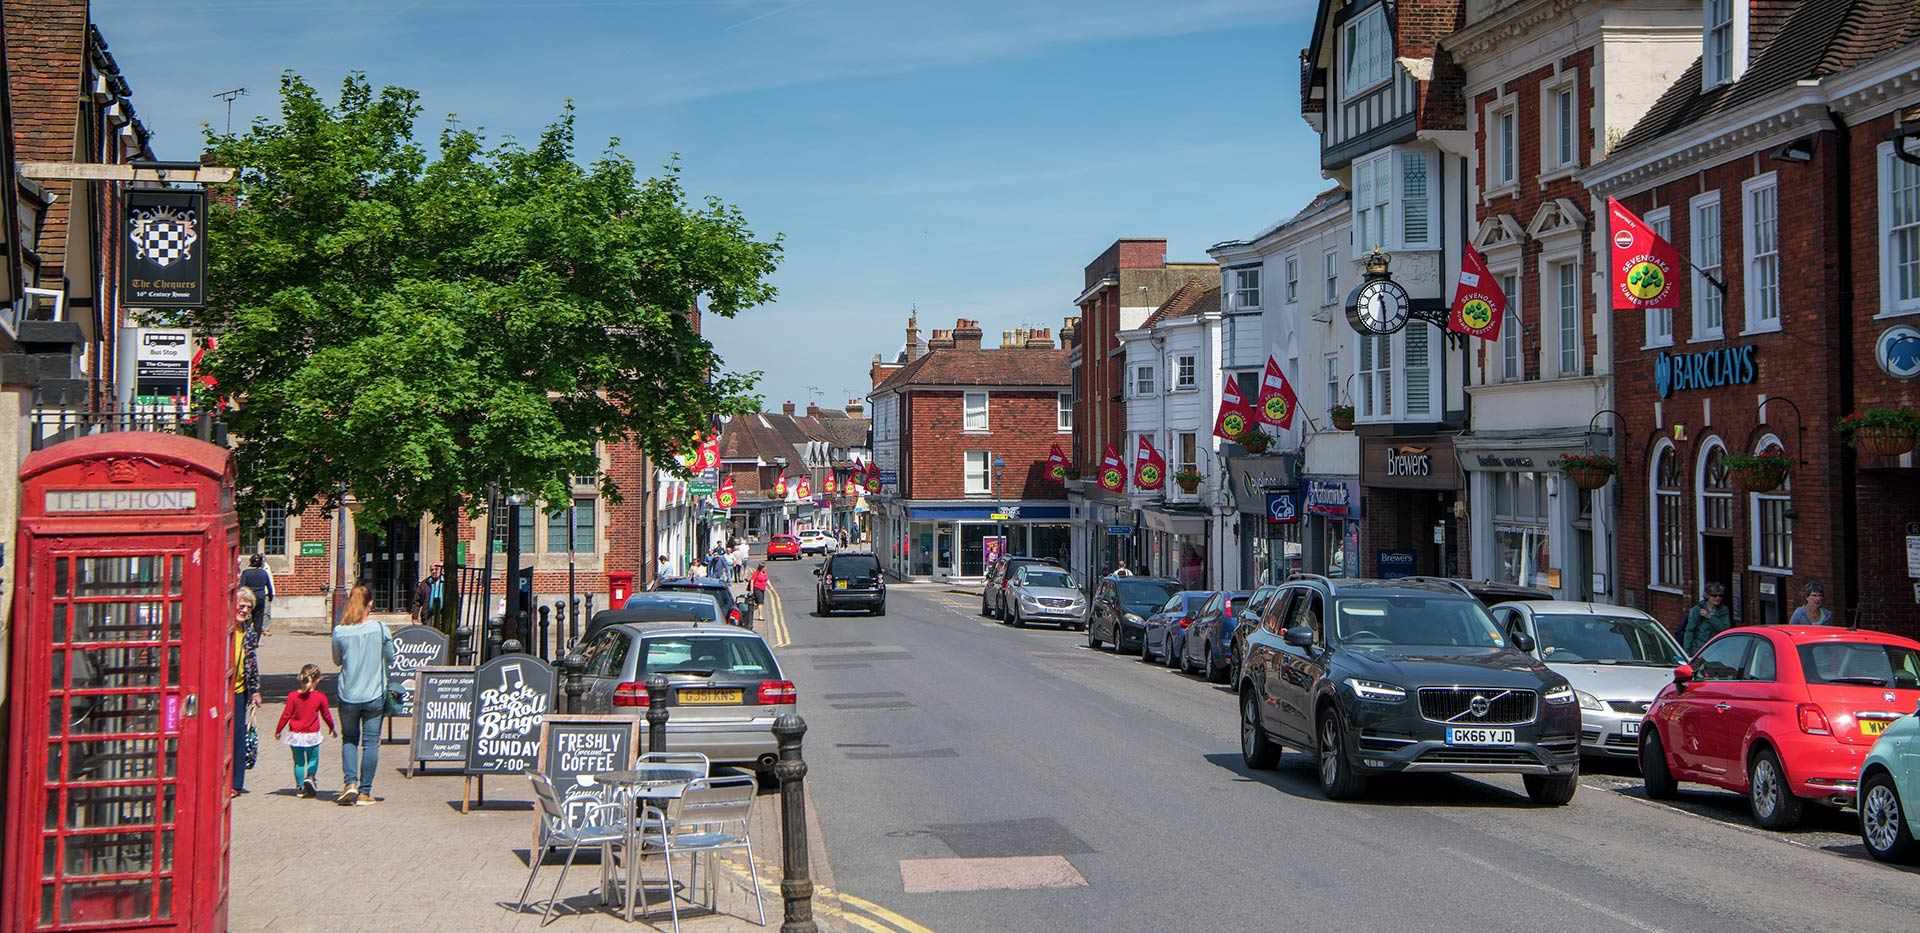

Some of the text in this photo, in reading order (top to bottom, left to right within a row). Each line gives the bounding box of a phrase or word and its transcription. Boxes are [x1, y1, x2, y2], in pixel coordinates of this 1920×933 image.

[1622, 255, 1670, 273] SEVENOAKS
[132, 279, 198, 289] The Chequers
[1620, 281, 1672, 306] SUMMER FESTIVAL
[1462, 293, 1497, 313] SEVENOAKS
[163, 348, 178, 356] Stop
[1674, 345, 1753, 391] BARCLAYS
[1387, 448, 1428, 476] Brewers
[56, 491, 190, 510] TELEPHONE
[1381, 552, 1413, 562] Brewers
[393, 637, 441, 661] Sunday
[480, 685, 535, 707] Rock
[482, 695, 546, 720] and Roll
[478, 712, 543, 739] Bingo
[558, 733, 621, 752] FRESHLY
[1455, 731, 1513, 743] GK66 YJD
[478, 739, 540, 756] SUNDAY
[494, 759, 524, 770] 7:00
[562, 753, 616, 772] COFFEE
